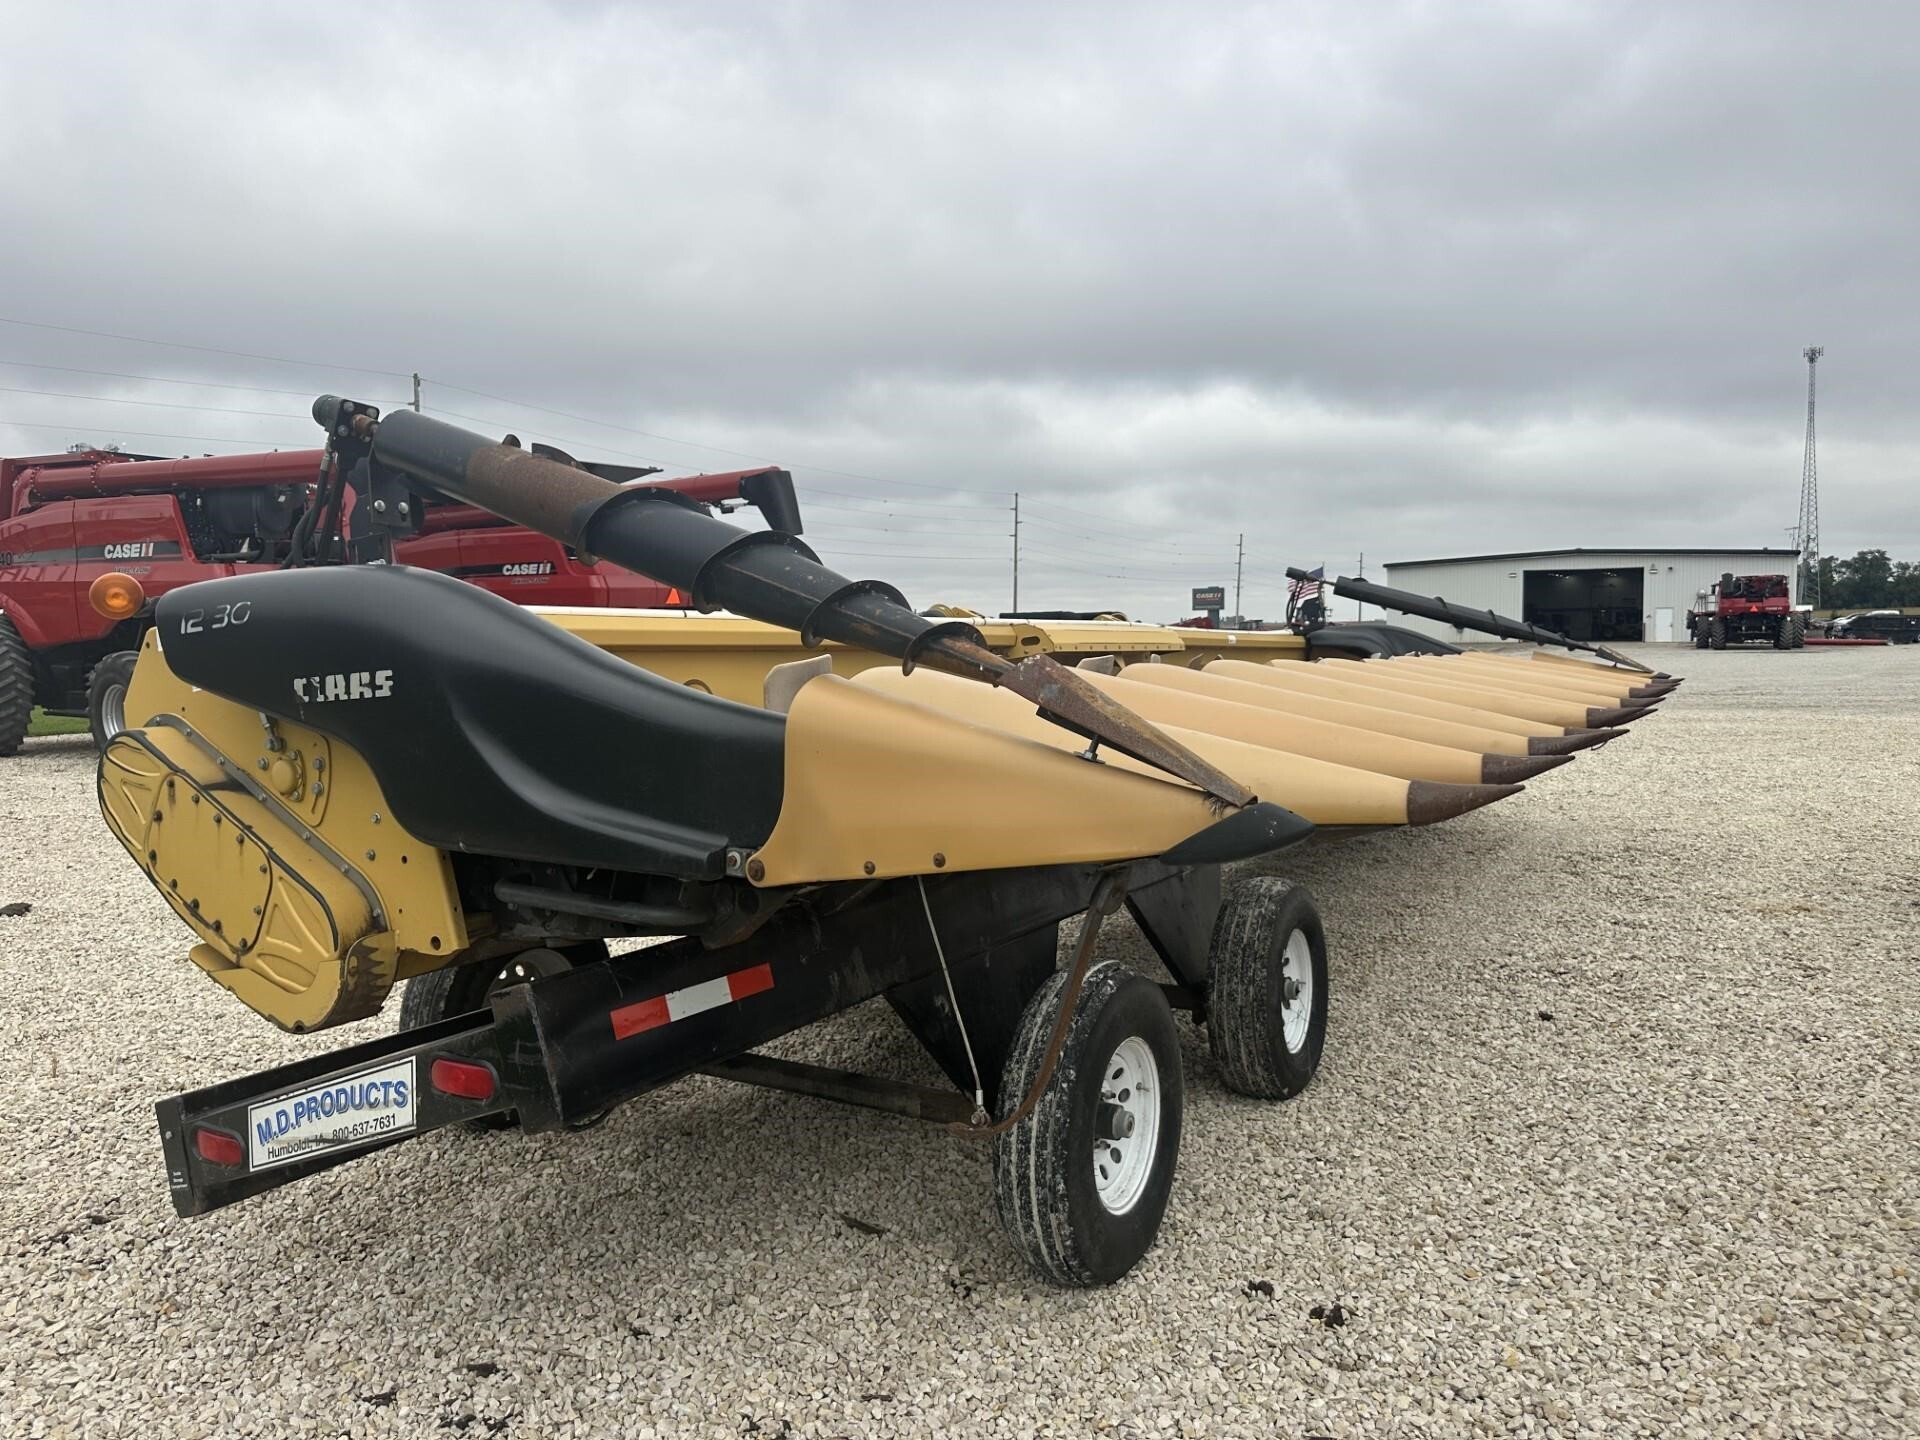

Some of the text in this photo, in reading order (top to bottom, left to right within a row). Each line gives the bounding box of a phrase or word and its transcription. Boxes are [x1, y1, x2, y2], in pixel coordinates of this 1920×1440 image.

[104, 544, 140, 559] CASE
[502, 564, 538, 575] CASE
[332, 1113, 396, 1142] 800-637-7631
